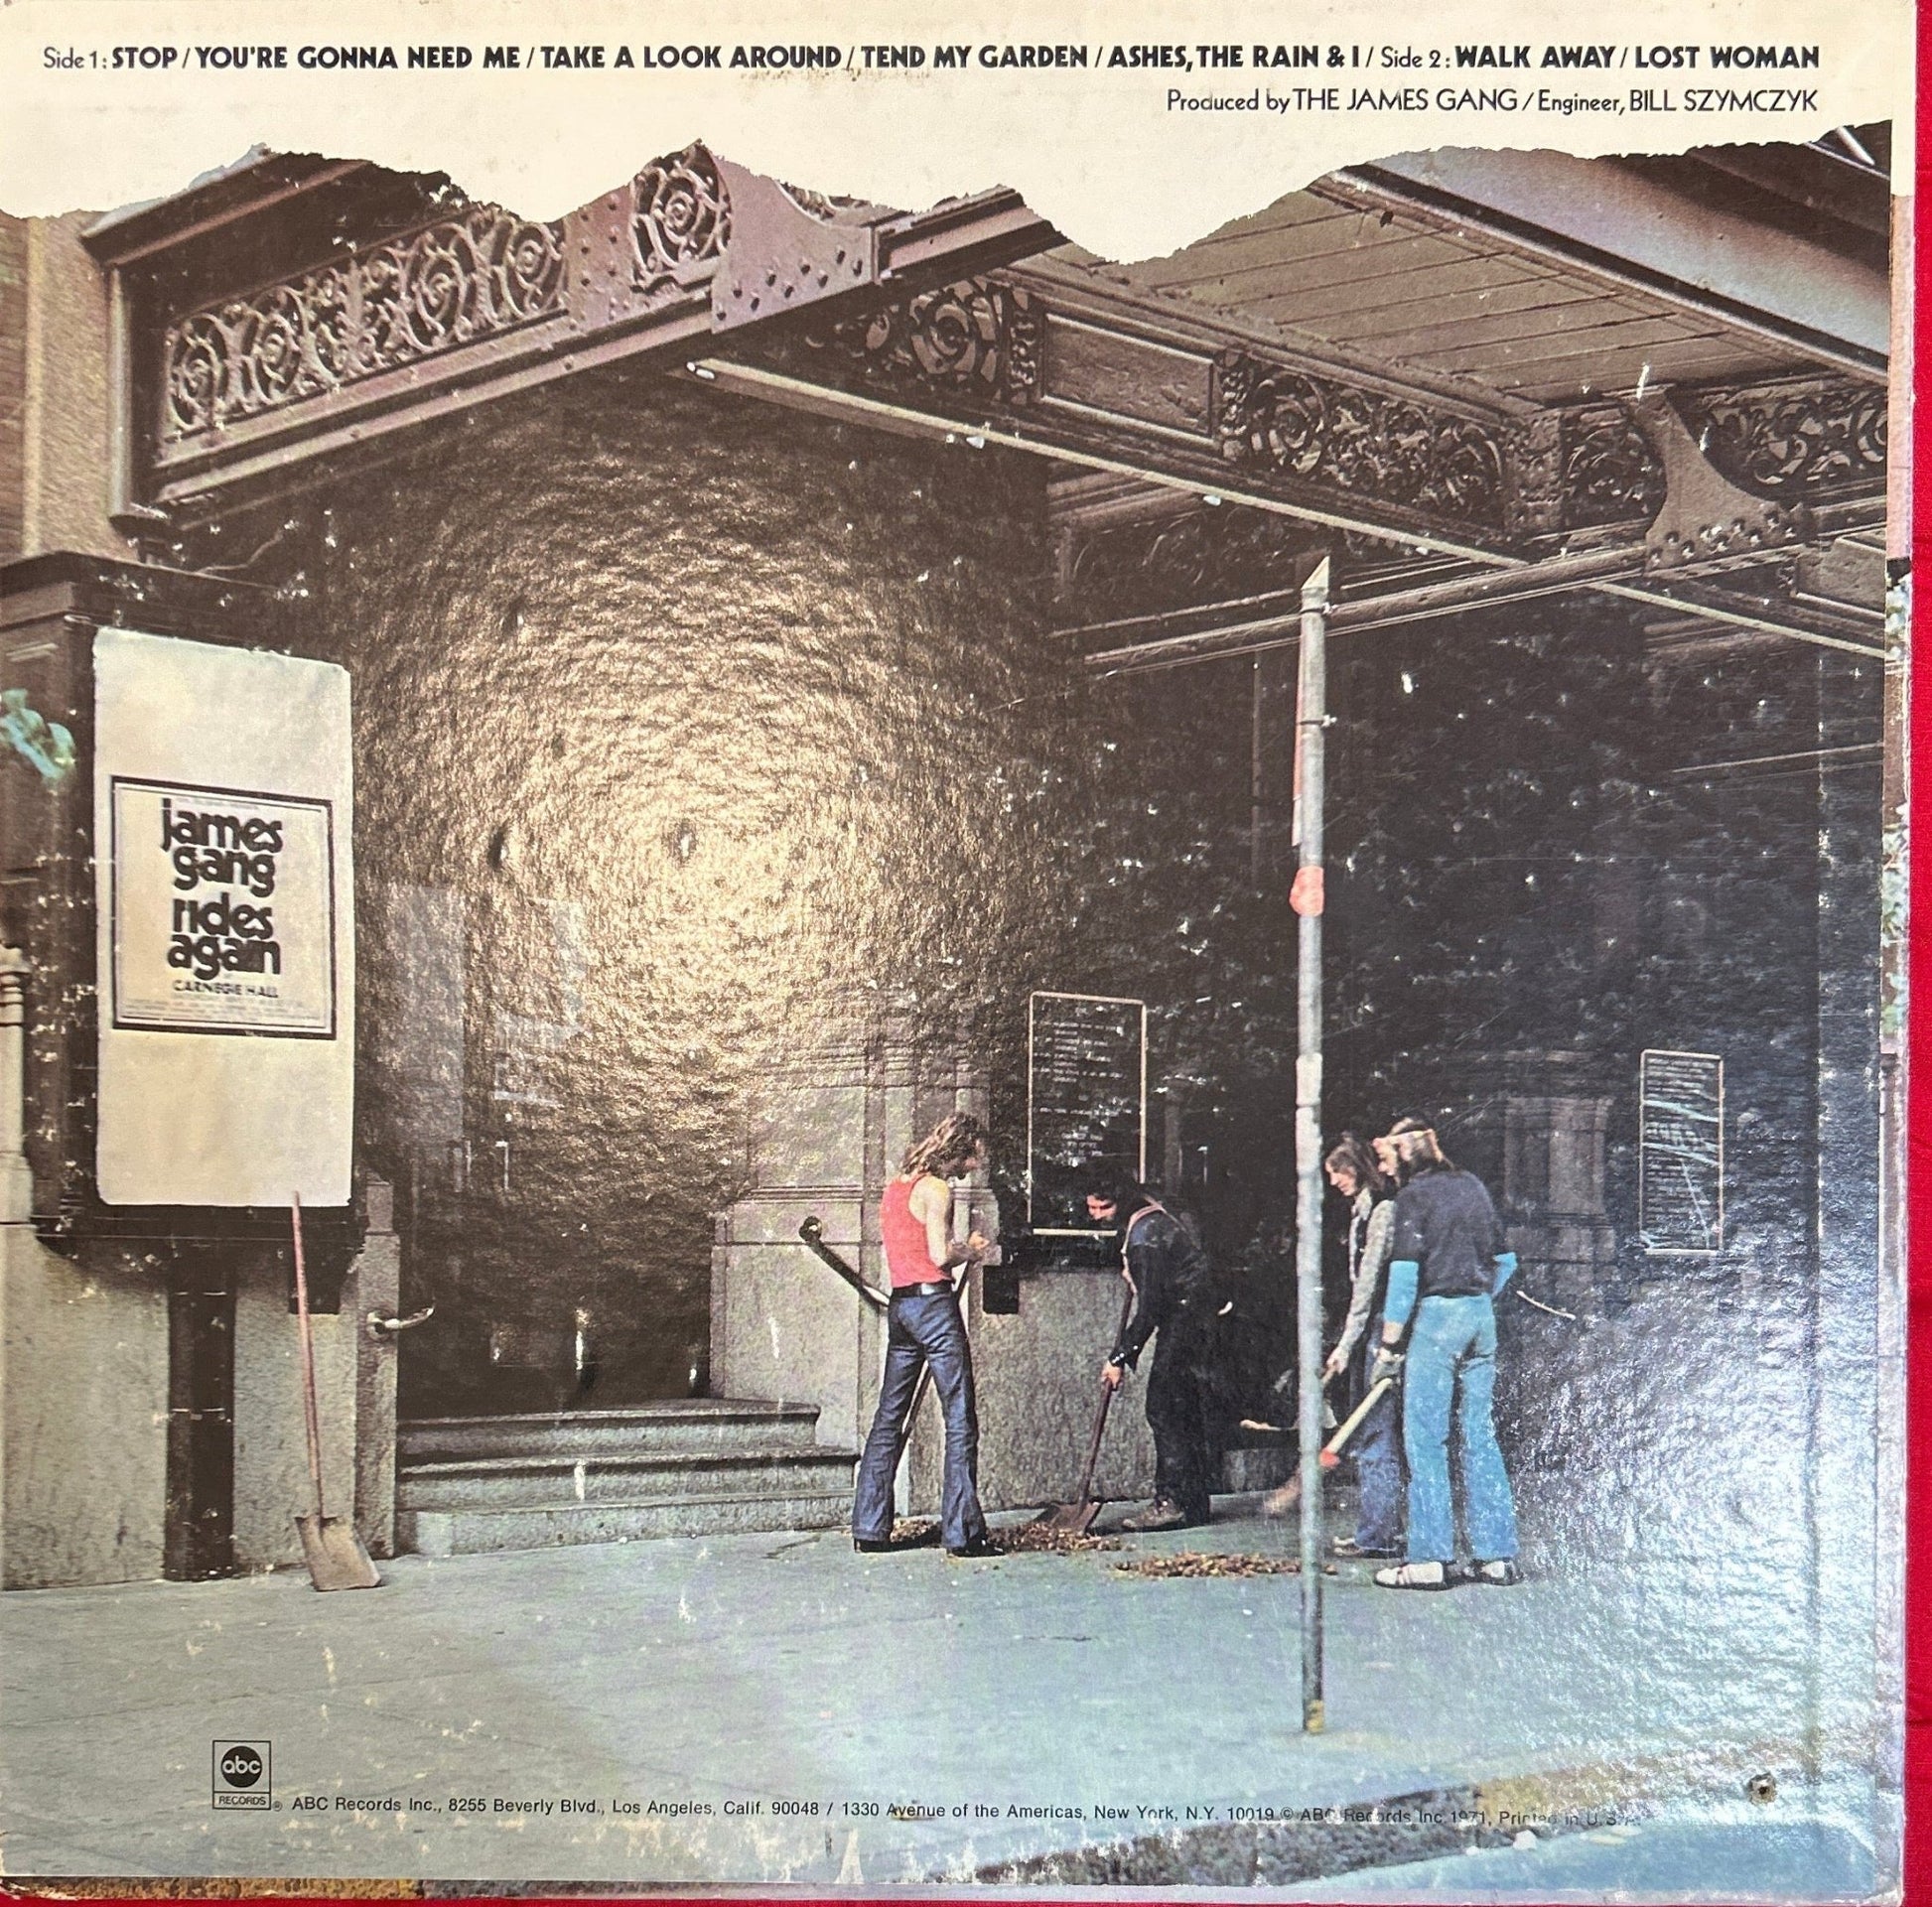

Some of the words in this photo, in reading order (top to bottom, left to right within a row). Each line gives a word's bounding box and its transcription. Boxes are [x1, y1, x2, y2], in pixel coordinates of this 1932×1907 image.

[43, 46, 84, 69] Side
[111, 46, 179, 69] STOP
[195, 46, 289, 69] YOU'RE
[298, 45, 399, 69] GONNA
[408, 46, 473, 69] NEED
[483, 46, 521, 69] ME
[539, 45, 606, 68] TAKE
[613, 45, 635, 68] A
[643, 45, 723, 69] LOOK
[728, 45, 842, 69] AROUND
[860, 45, 926, 68] TEND
[933, 45, 973, 68] MY
[977, 45, 1088, 68] GARDEN
[1195, 45, 1244, 68] THE
[1252, 45, 1319, 68] RAIN
[1326, 45, 1346, 68] &
[1380, 45, 1424, 68] Side
[1454, 45, 1532, 68] WALK
[1540, 45, 1617, 68] AWAY
[1634, 45, 1701, 69] LOST
[1710, 45, 1820, 69] WOMAN
[1167, 87, 1260, 111] Produced
[1266, 87, 1291, 115] by
[1292, 87, 1340, 111] THE
[1346, 87, 1430, 111] JAMES
[1436, 87, 1518, 112] GANG
[1538, 88, 1626, 116] Engineer,
[1629, 88, 1678, 112] BILL
[1683, 88, 1820, 112] SZYMCZYK
[161, 797, 283, 854] james
[172, 846, 276, 897] gang
[172, 891, 274, 941] rides
[167, 933, 281, 981] again
[173, 980, 242, 996] CARNEGIE
[246, 984, 279, 999] HALL
[221, 1754, 261, 1774] abc
[218, 1795, 266, 1806] RECORDS
[291, 1796, 329, 1811] ABC
[335, 1796, 402, 1812] Records
[409, 1797, 442, 1814] Inc.,
[448, 1797, 487, 1813] 8255
[493, 1798, 555, 1817] Beverly
[560, 1799, 606, 1817] Blvd.,
[612, 1799, 641, 1815] Los
[646, 1799, 717, 1818] Angeles,
[723, 1800, 765, 1816] Calif.
[771, 1801, 819, 1816] 90048
[842, 1802, 880, 1817] 1330
[886, 1802, 946, 1818] Avenue
[951, 1803, 969, 1818] of
[974, 1803, 1000, 1818] the
[1006, 1803, 1088, 1822] Americas,
[1094, 1805, 1130, 1820] New
[1185, 1805, 1219, 1821] N.Y.
[1226, 1806, 1275, 1821] 10019
[1300, 1807, 1337, 1822] ABC
[1344, 1808, 1412, 1823] Records
